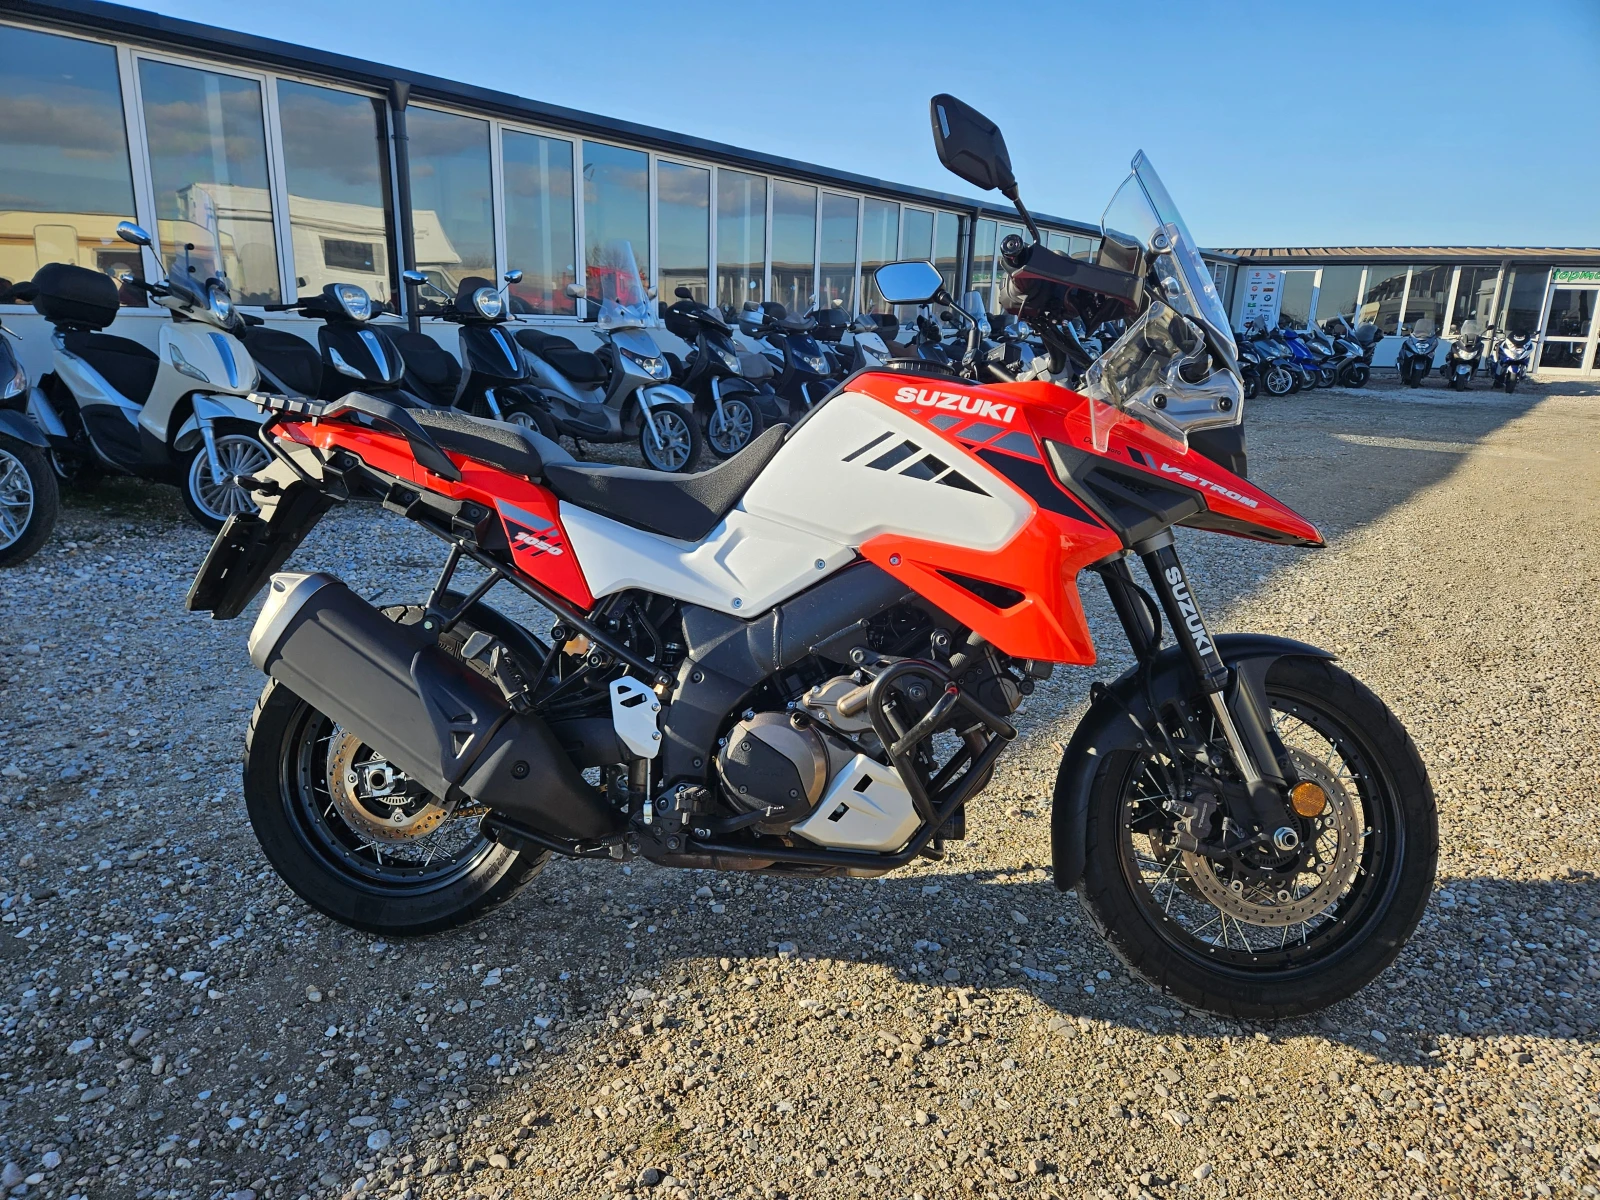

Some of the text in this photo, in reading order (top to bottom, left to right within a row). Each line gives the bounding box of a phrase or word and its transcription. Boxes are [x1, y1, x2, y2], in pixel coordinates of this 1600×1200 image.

[894, 386, 1017, 423] SUZUKI
[1160, 462, 1259, 509] V-STROM
[514, 531, 564, 556] 1050
[1165, 566, 1214, 656] SUZUKI
